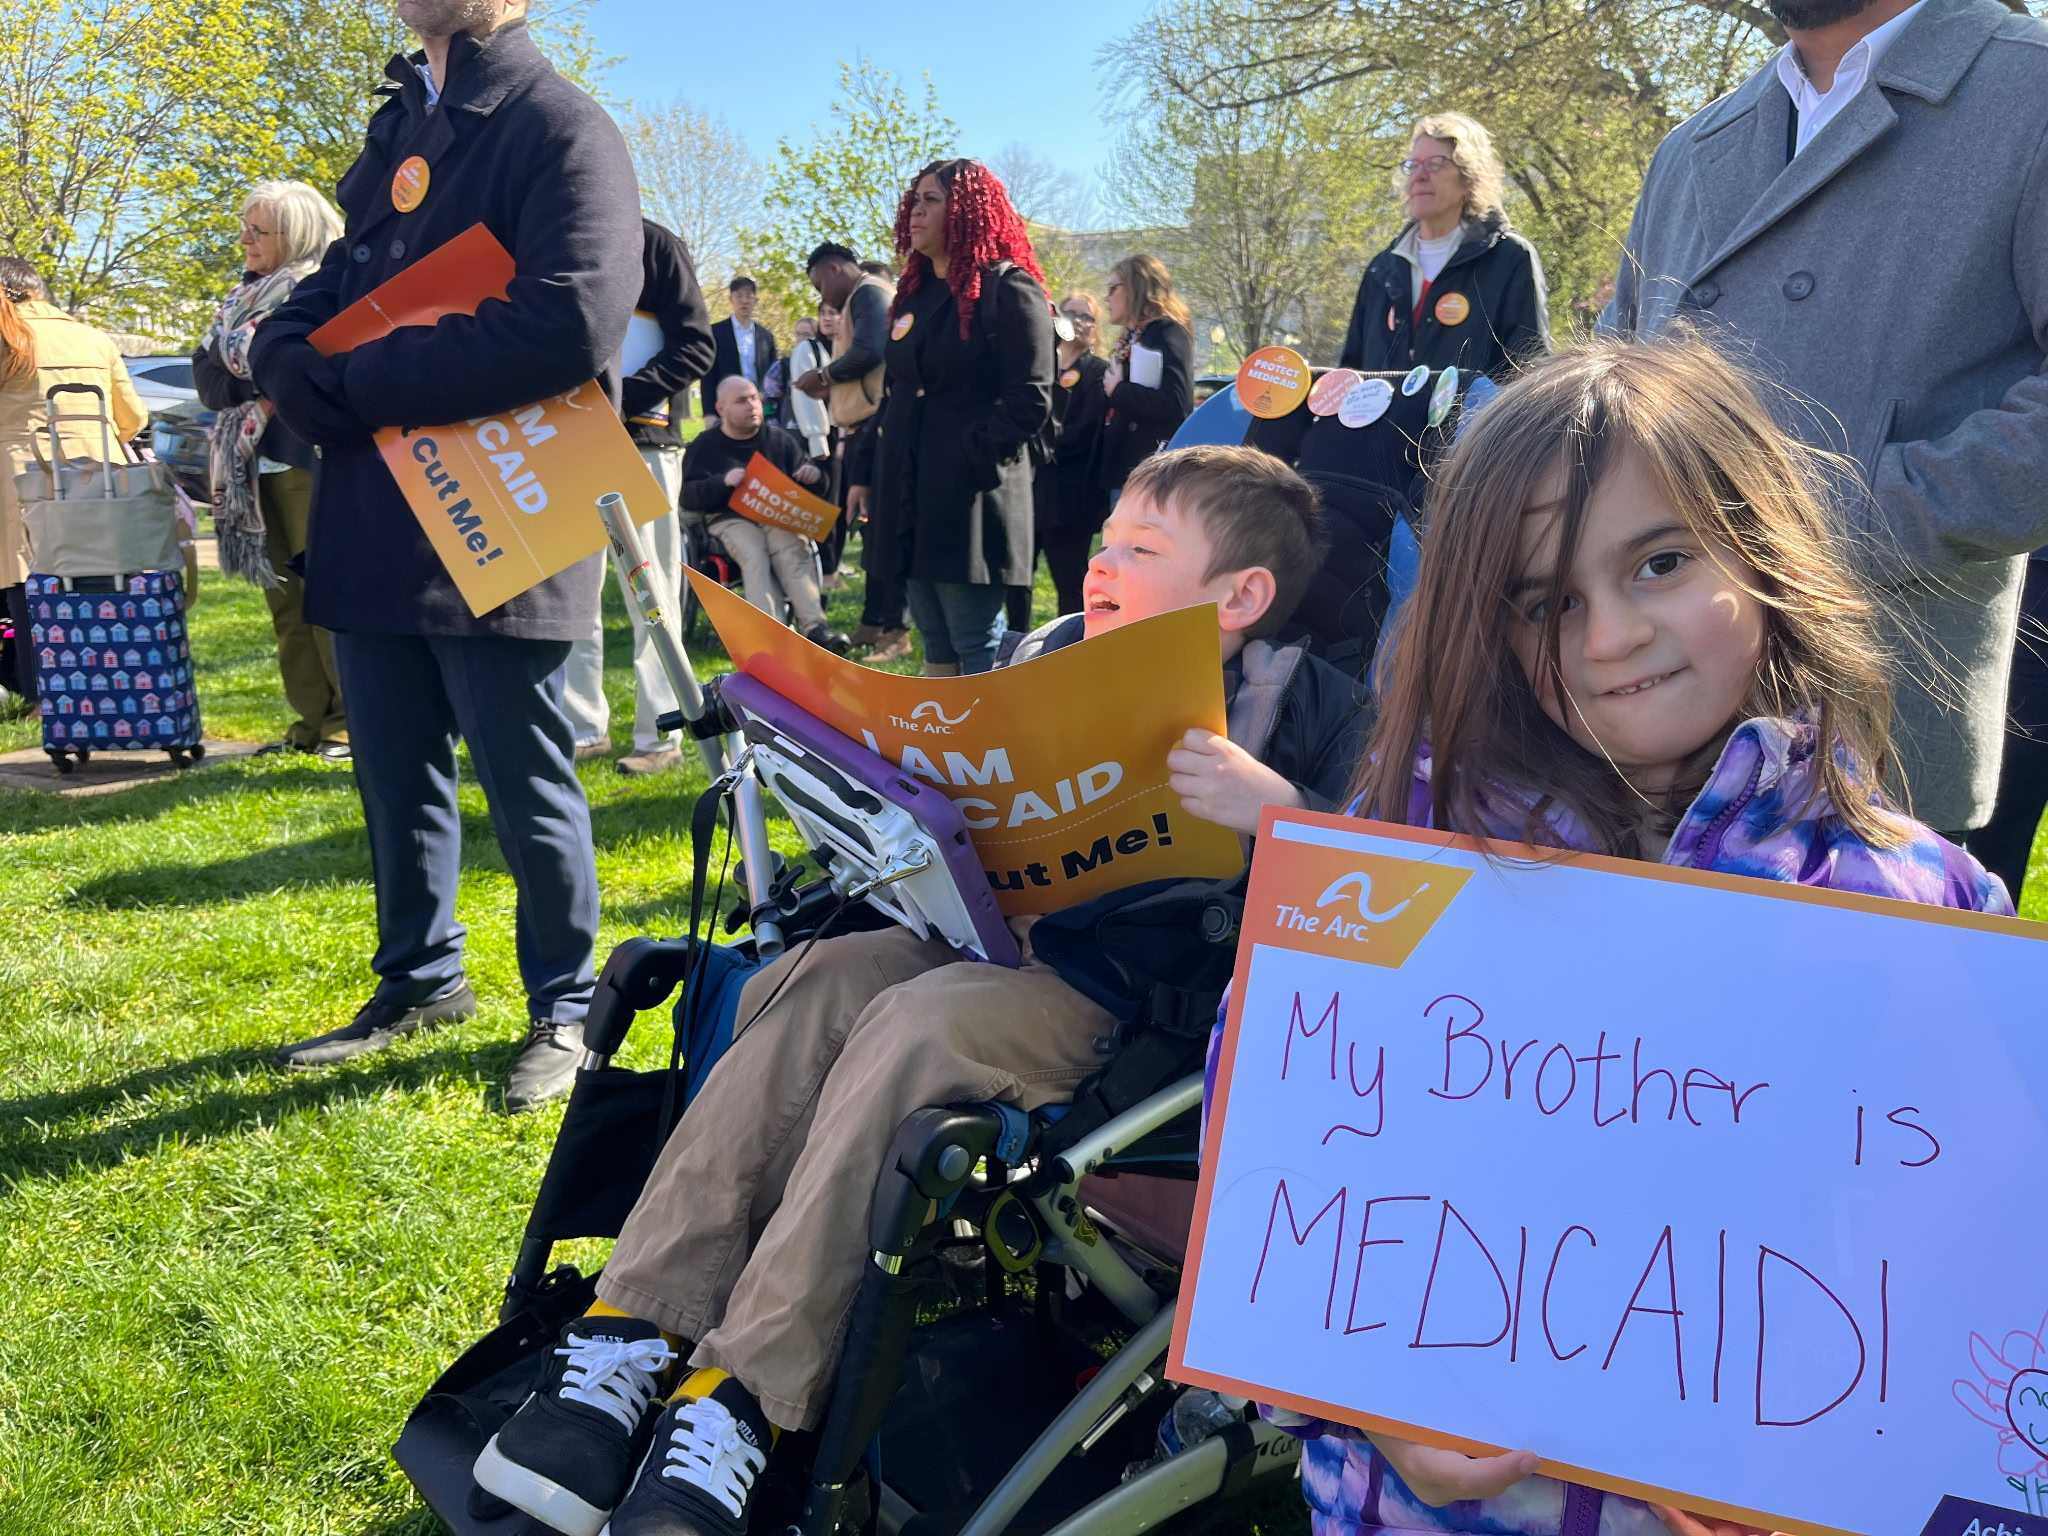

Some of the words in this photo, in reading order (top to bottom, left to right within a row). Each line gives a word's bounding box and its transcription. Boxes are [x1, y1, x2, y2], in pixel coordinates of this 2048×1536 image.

[1247, 369, 1298, 389] MEDICAID
[1254, 359, 1300, 377] PROTECT
[511, 405, 558, 447] M
[470, 417, 549, 515] CAID
[412, 437, 461, 501] Cut
[446, 497, 504, 566] Me!
[741, 492, 819, 533] MEDICAID
[748, 478, 824, 524] PROTECT
[888, 715, 919, 732] The
[924, 722, 953, 735] Arc
[900, 744, 1014, 786] AM
[951, 761, 1124, 829] CAID
[988, 862, 1052, 891] ut
[1061, 812, 1173, 880] Me!
[1275, 904, 1320, 932] The
[1323, 915, 1368, 942] Arc
[1281, 990, 1384, 1145] My
[1423, 994, 1770, 1127] Brother
[1852, 1088, 1941, 1167] is
[1250, 1179, 1889, 1436] MEDICAID!
